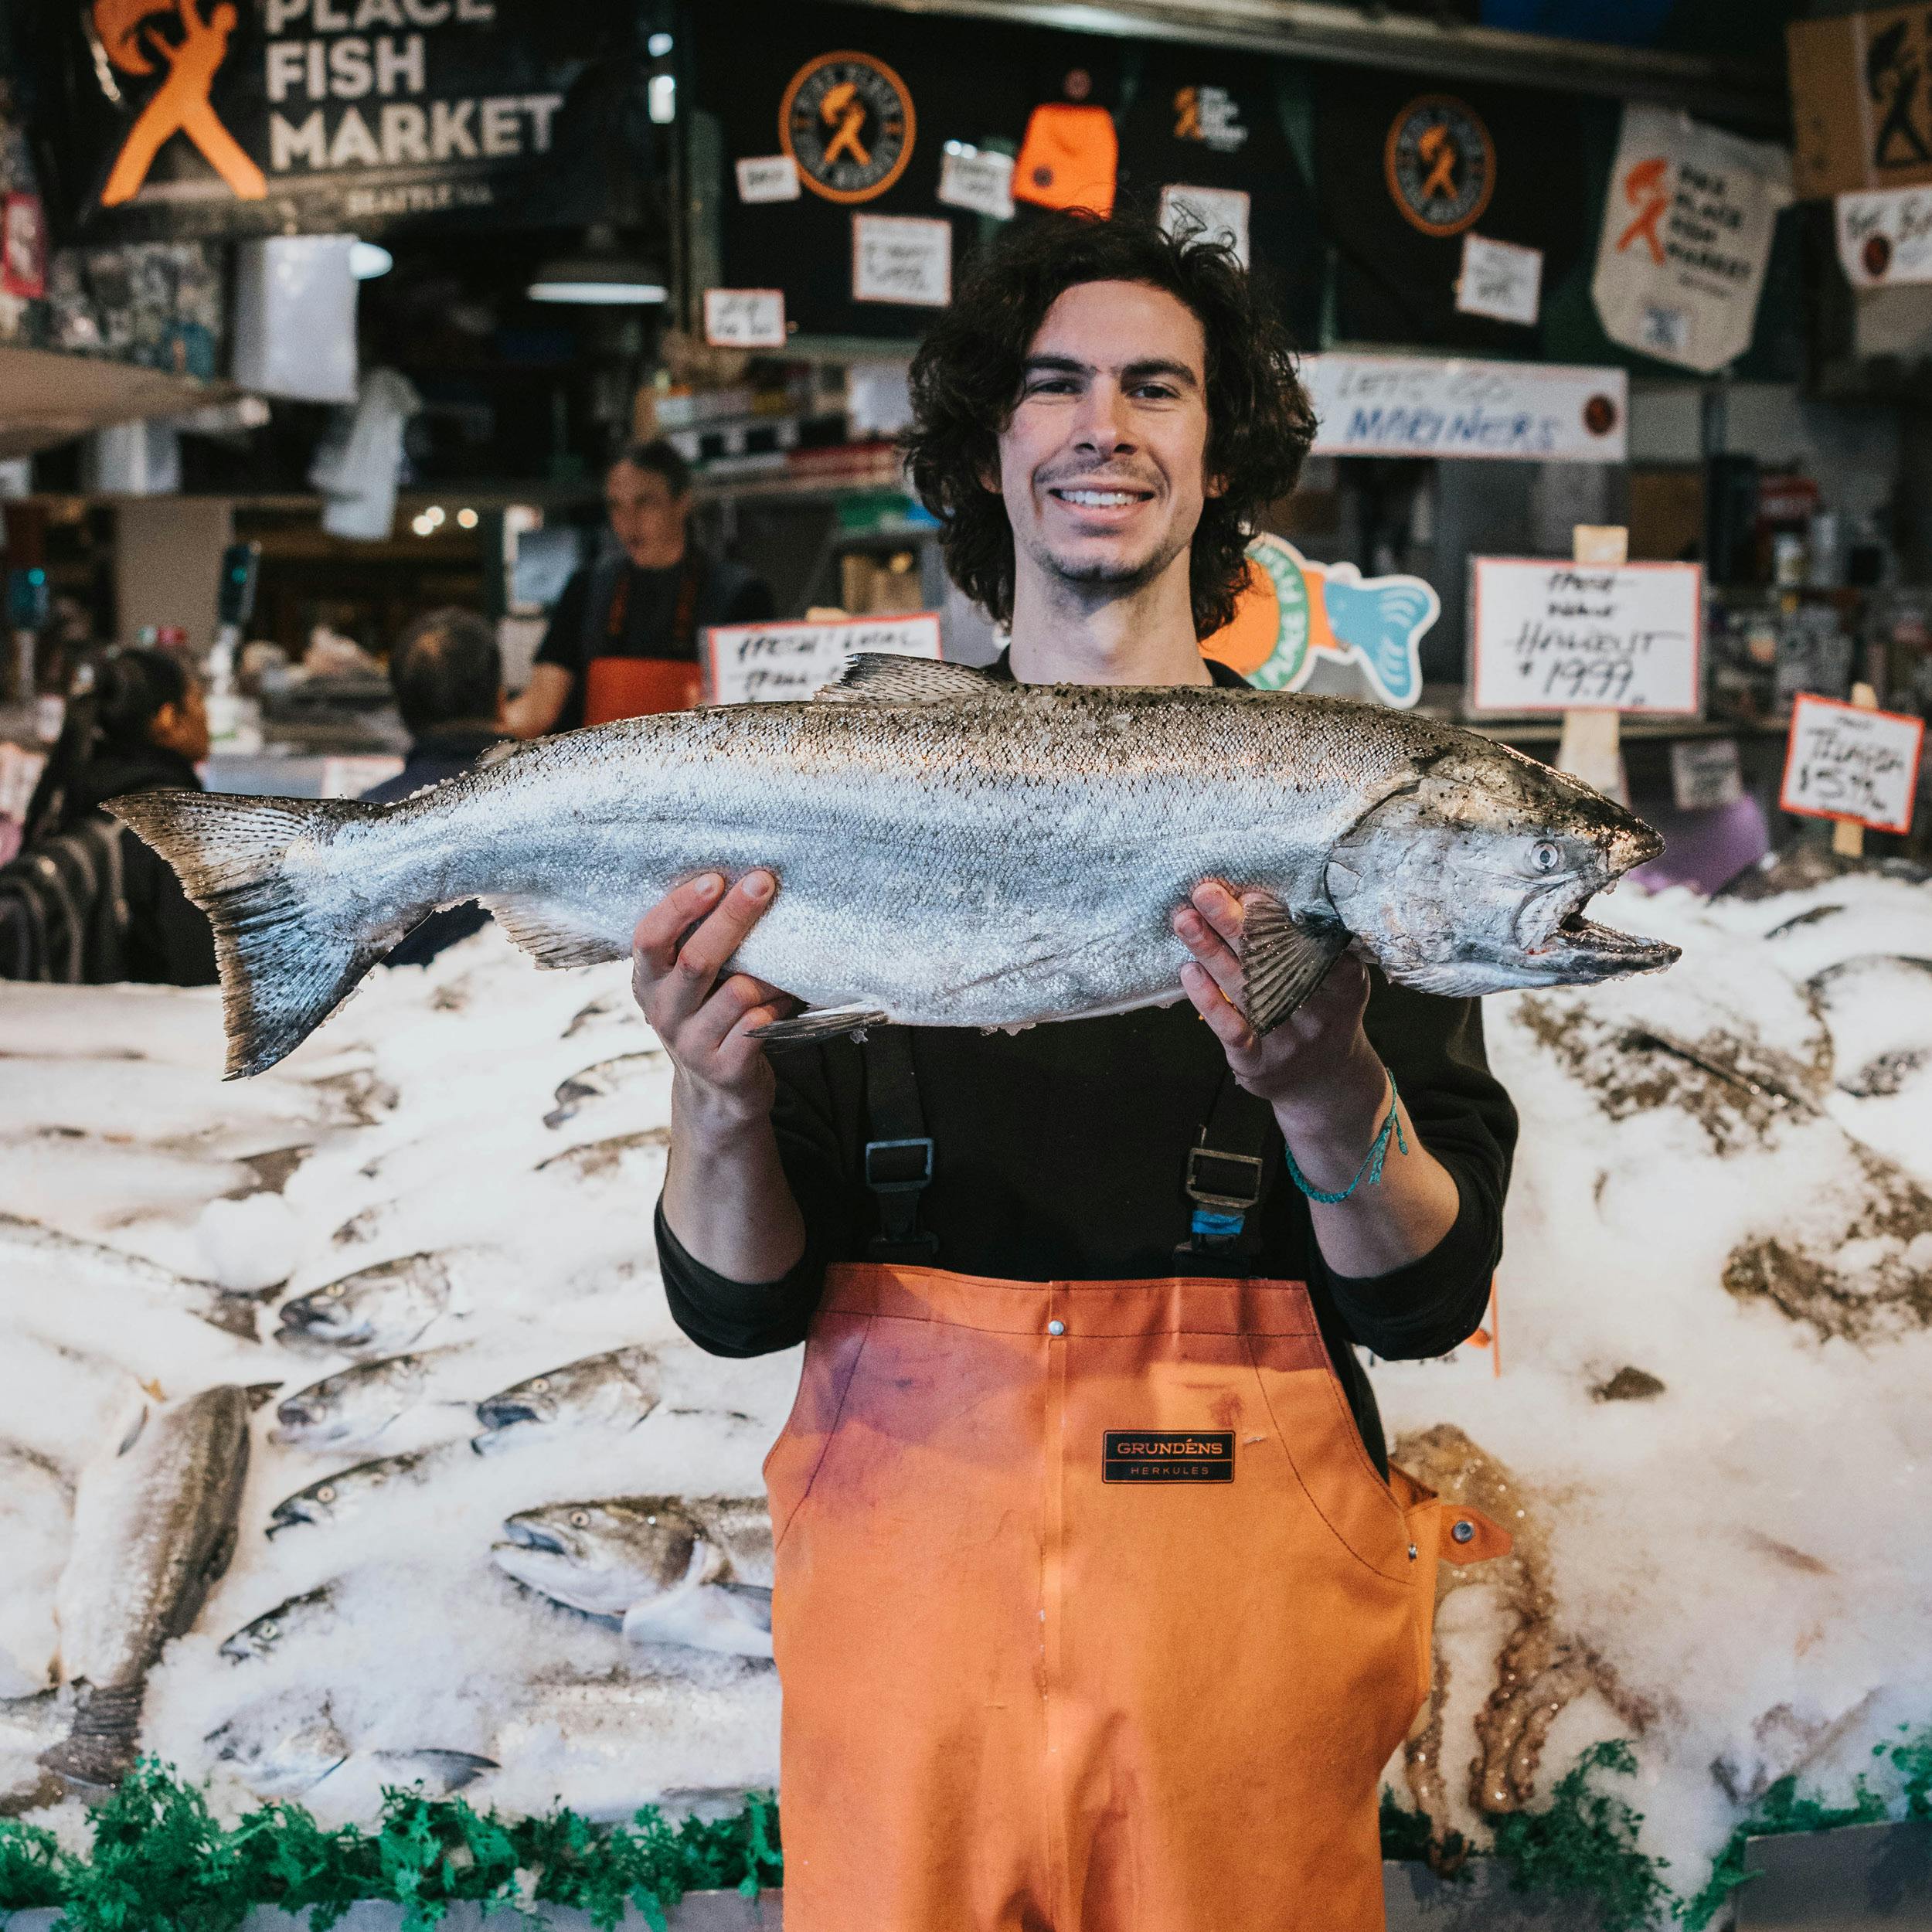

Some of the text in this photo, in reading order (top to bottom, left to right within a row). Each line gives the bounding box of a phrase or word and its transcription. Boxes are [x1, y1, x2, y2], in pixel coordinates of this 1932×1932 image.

[266, 33, 426, 103] FISH
[269, 92, 565, 172] MARKET
[1117, 1438, 1223, 1455] GRUNDÉNS
